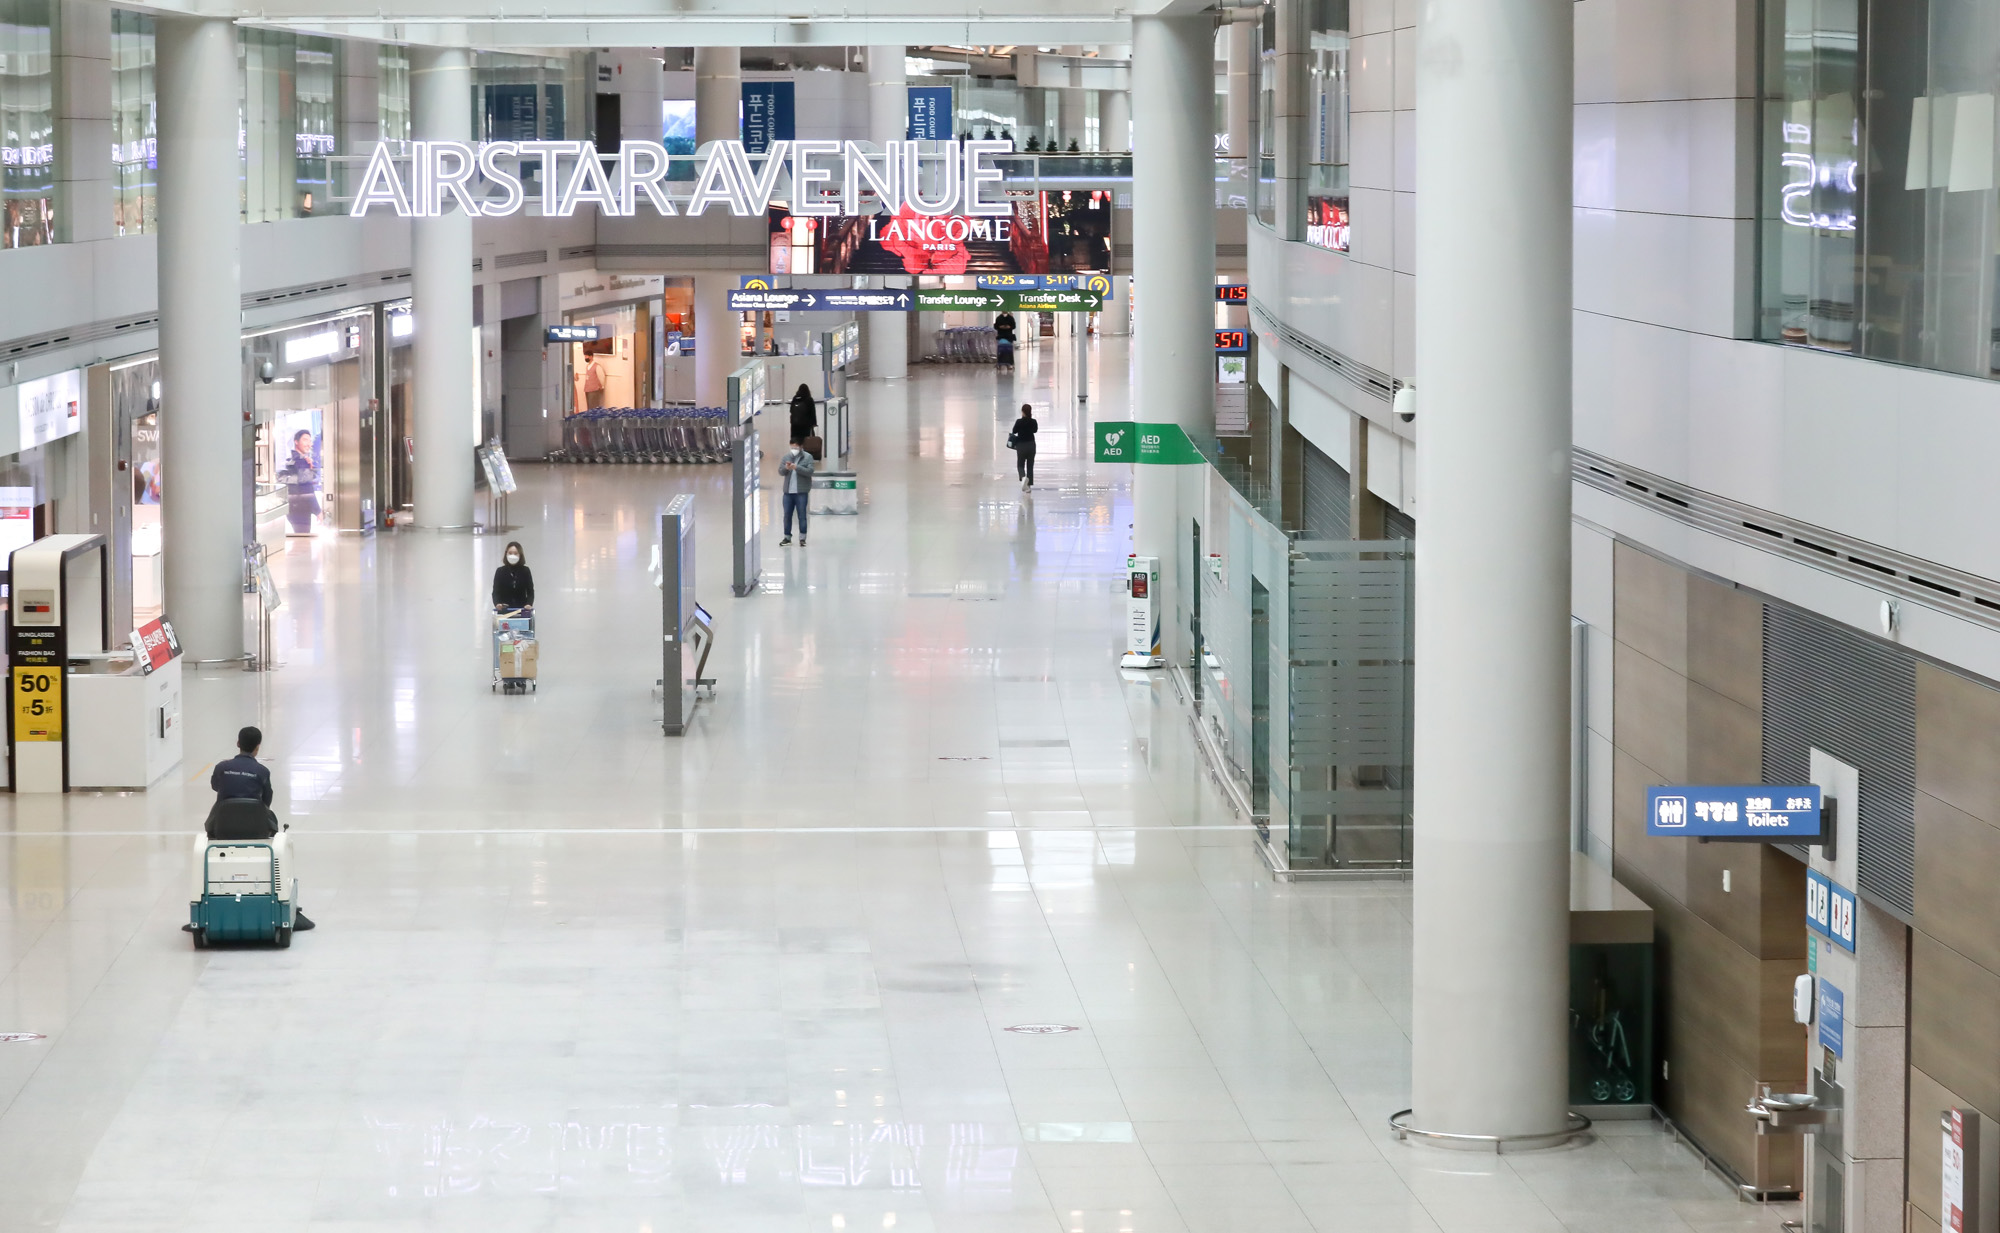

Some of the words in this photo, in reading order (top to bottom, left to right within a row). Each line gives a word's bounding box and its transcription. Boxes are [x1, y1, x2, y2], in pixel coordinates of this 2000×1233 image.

[768, 94, 776, 116] FOOD
[350, 140, 679, 217] AIRSTAR
[686, 140, 1012, 217] AVENUE
[868, 214, 1011, 242] LANCÔME
[922, 243, 956, 251] PARIS
[987, 275, 1015, 285] 12-25
[1046, 275, 1069, 285] 5-11
[731, 292, 763, 302] Asiana
[764, 292, 799, 304] Lounge
[918, 294, 953, 304] Transfer
[954, 294, 987, 306] Lounge
[1019, 293, 1057, 303] Transfer
[1058, 293, 1081, 303] Desk
[1141, 435, 1160, 444] AED
[1694, 801, 1738, 822] 화장실
[1745, 813, 1789, 827] Toilets
